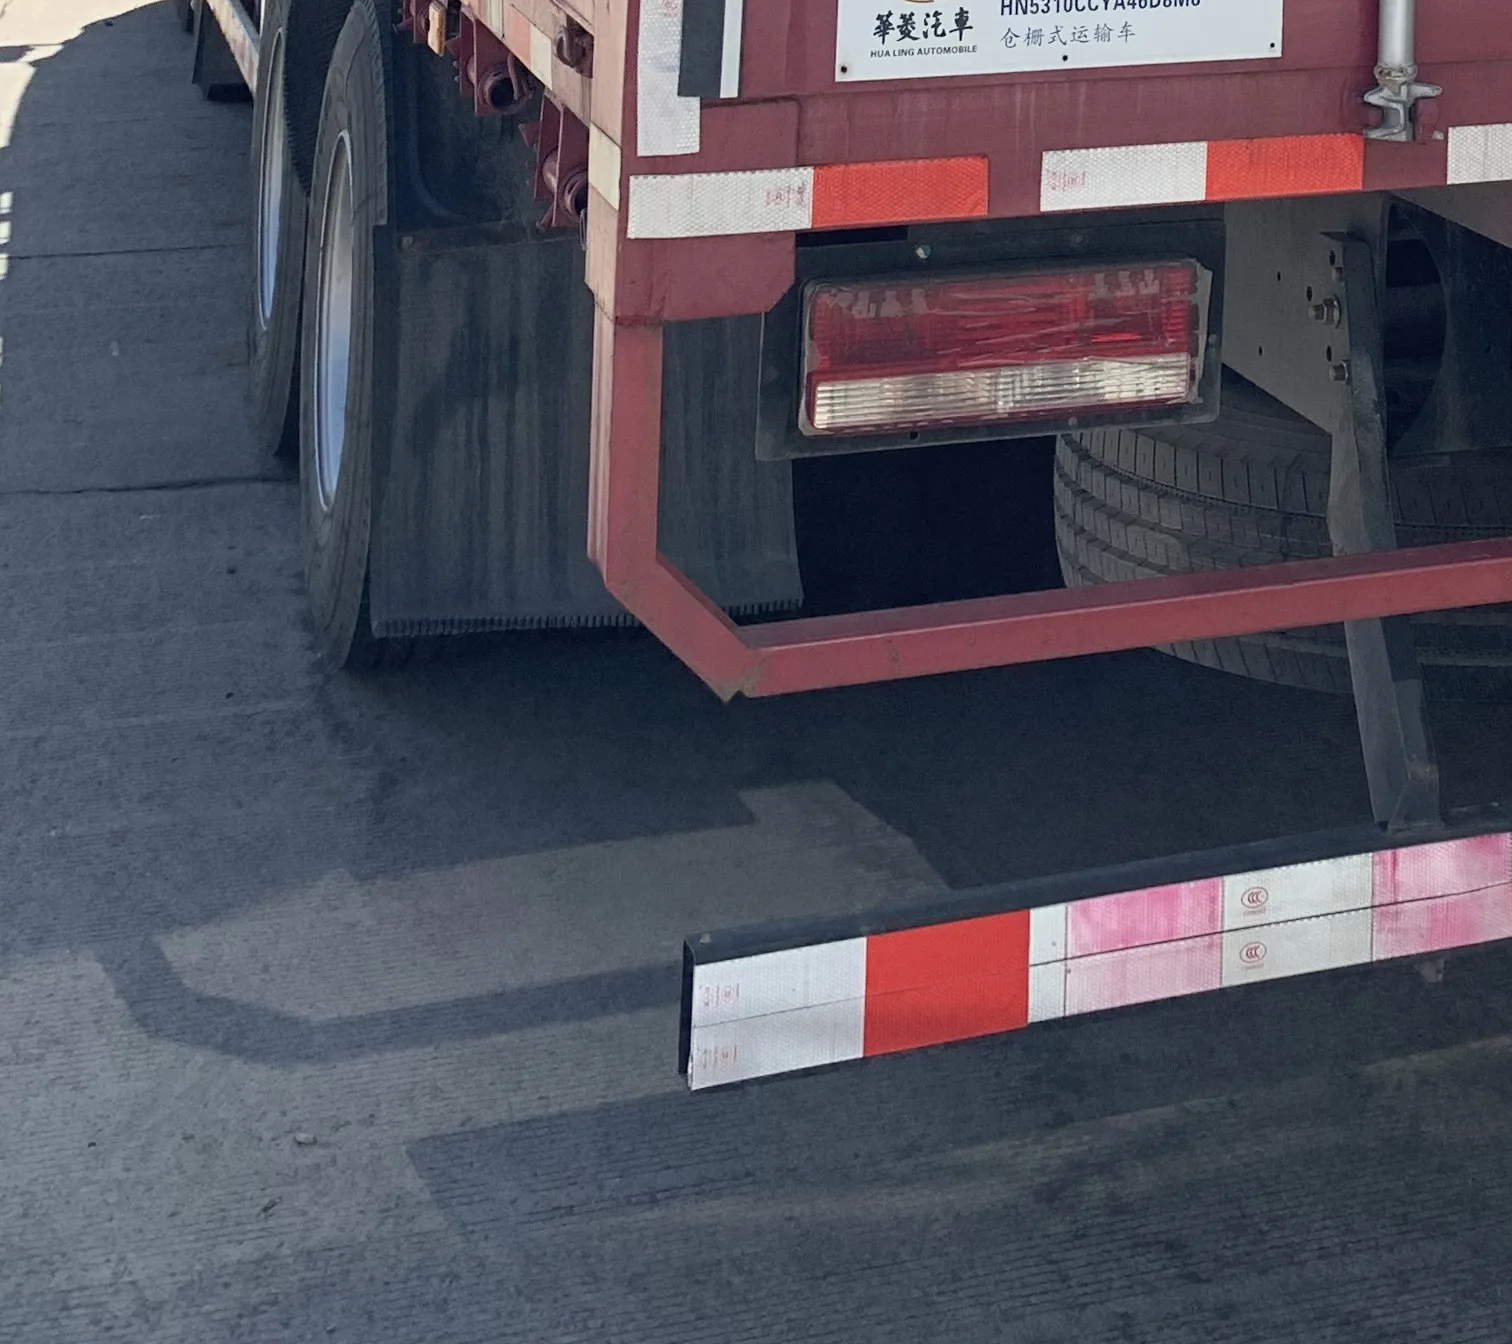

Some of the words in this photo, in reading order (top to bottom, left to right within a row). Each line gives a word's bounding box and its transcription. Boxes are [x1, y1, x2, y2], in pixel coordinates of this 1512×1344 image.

[1000, 20, 1136, 49] 仓栅式运输车
[870, 50, 891, 58] HUA
[893, 47, 915, 57] LING
[917, 45, 978, 57] AUTOMOBILE
